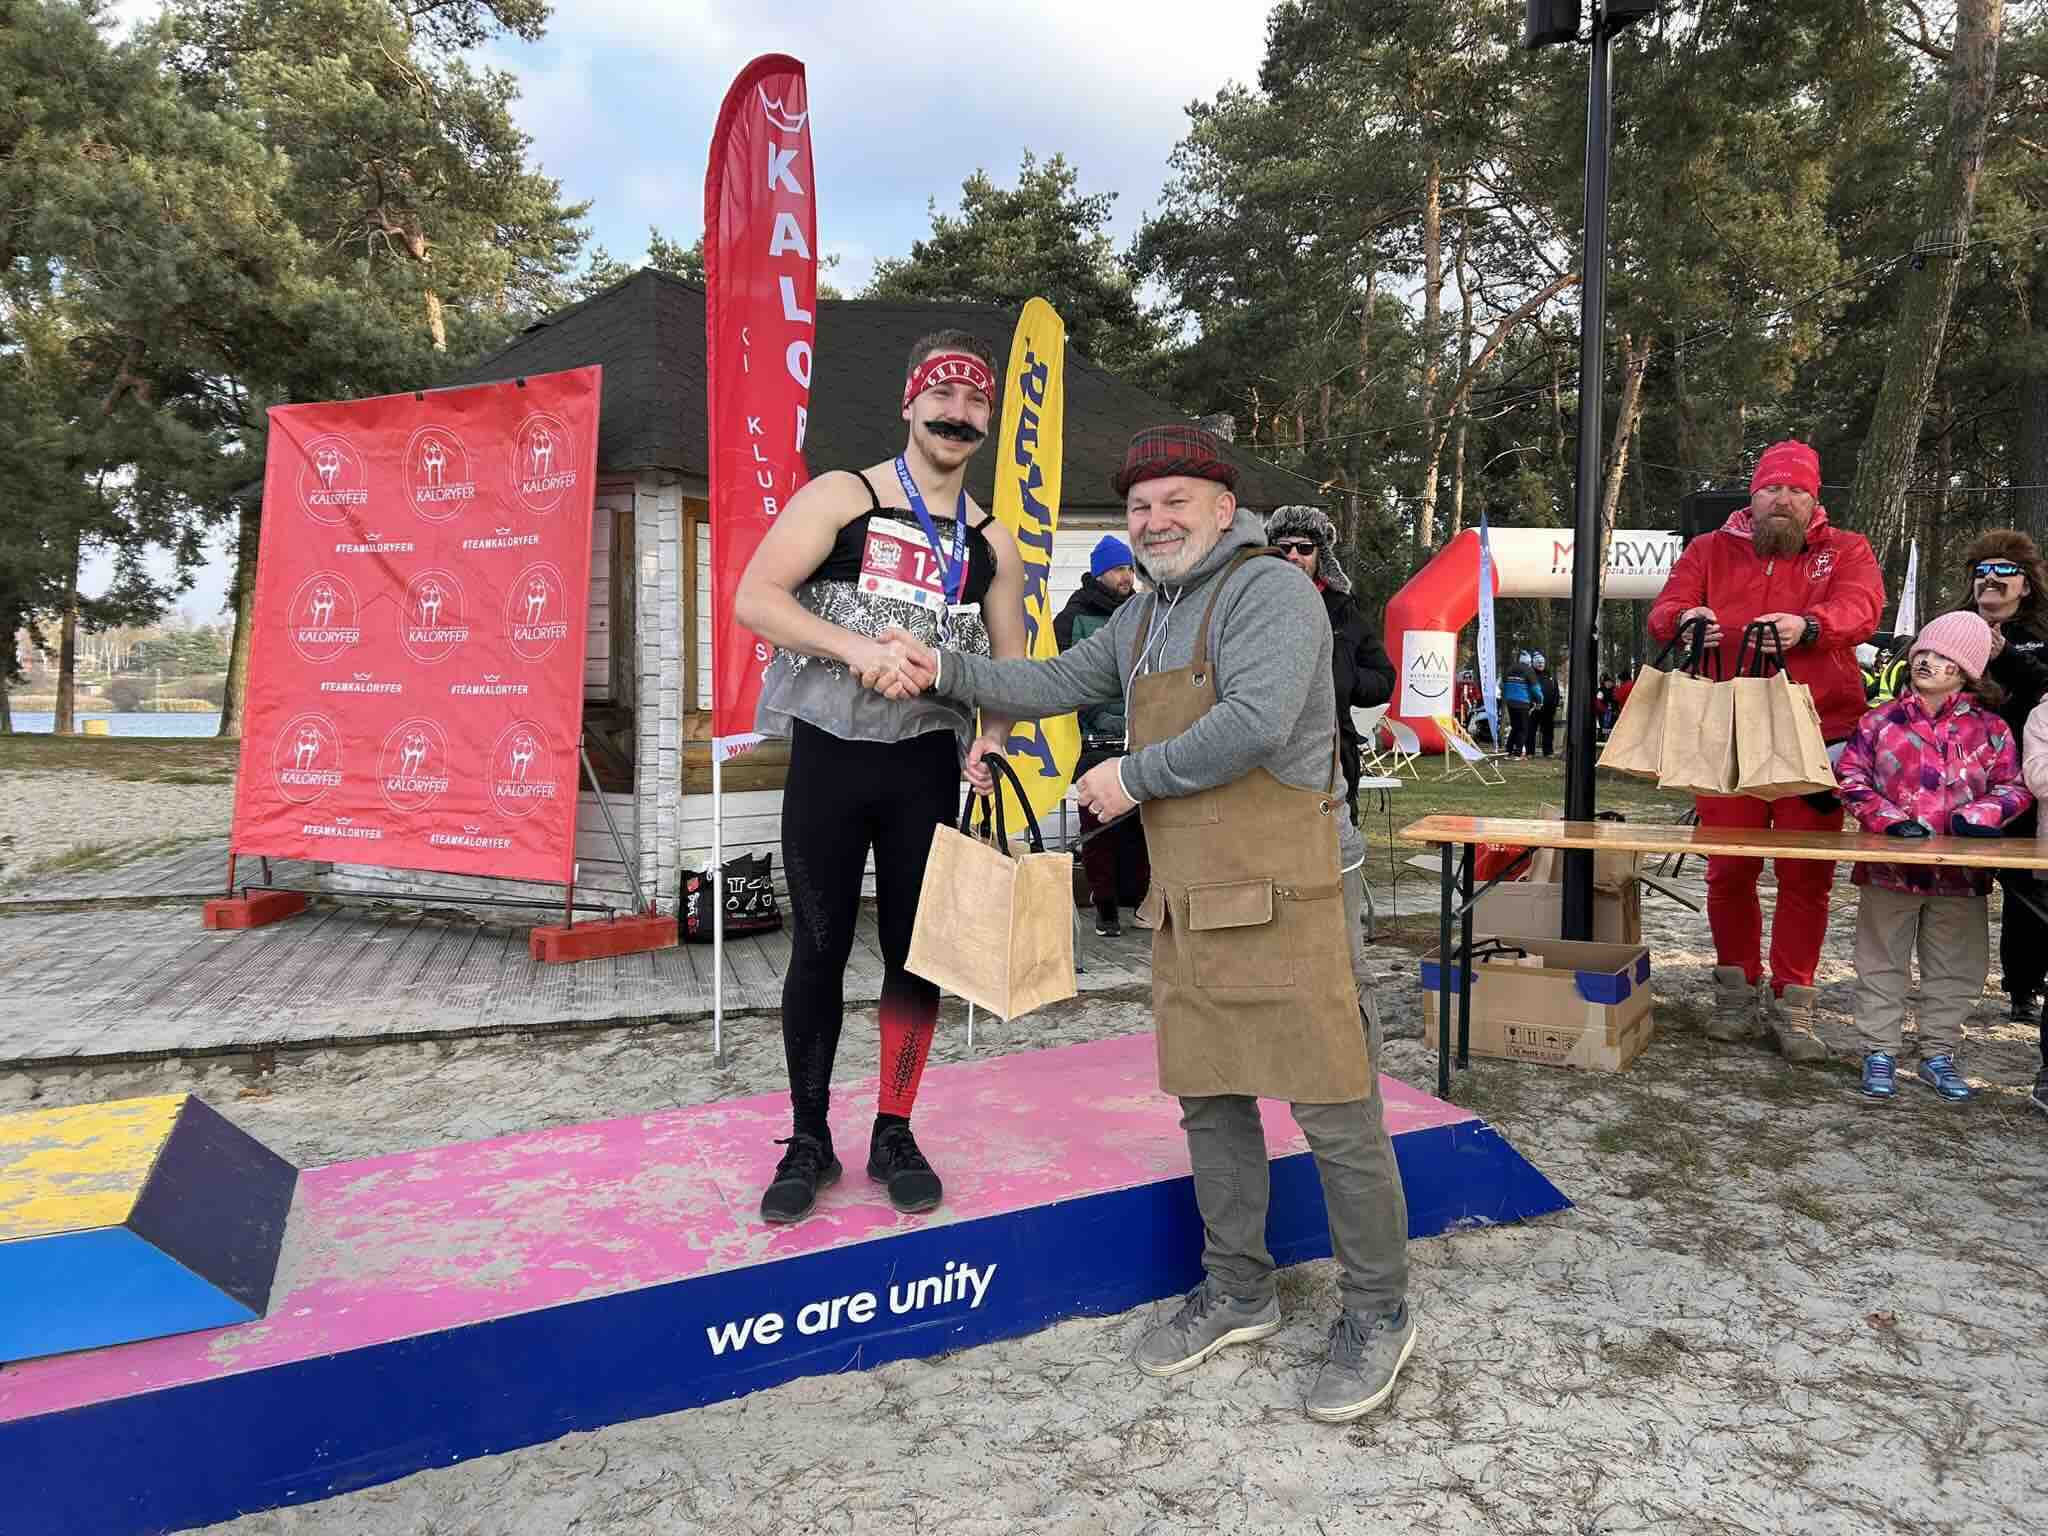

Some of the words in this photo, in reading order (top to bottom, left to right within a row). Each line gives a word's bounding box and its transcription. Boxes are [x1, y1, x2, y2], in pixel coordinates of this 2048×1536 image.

[746, 415, 779, 516] KLUB
[521, 473, 577, 494] KALORYFER
[415, 486, 475, 502] KALORYFER
[298, 631, 360, 643] KALORYFER
[408, 630, 469, 642] KALORYFER
[513, 625, 568, 641] KALORYFER
[280, 772, 342, 786] KALORYFER
[387, 780, 448, 793] KALORYFER
[706, 1312, 785, 1356] we
[796, 1291, 878, 1336] are
[888, 1260, 998, 1315] unity
